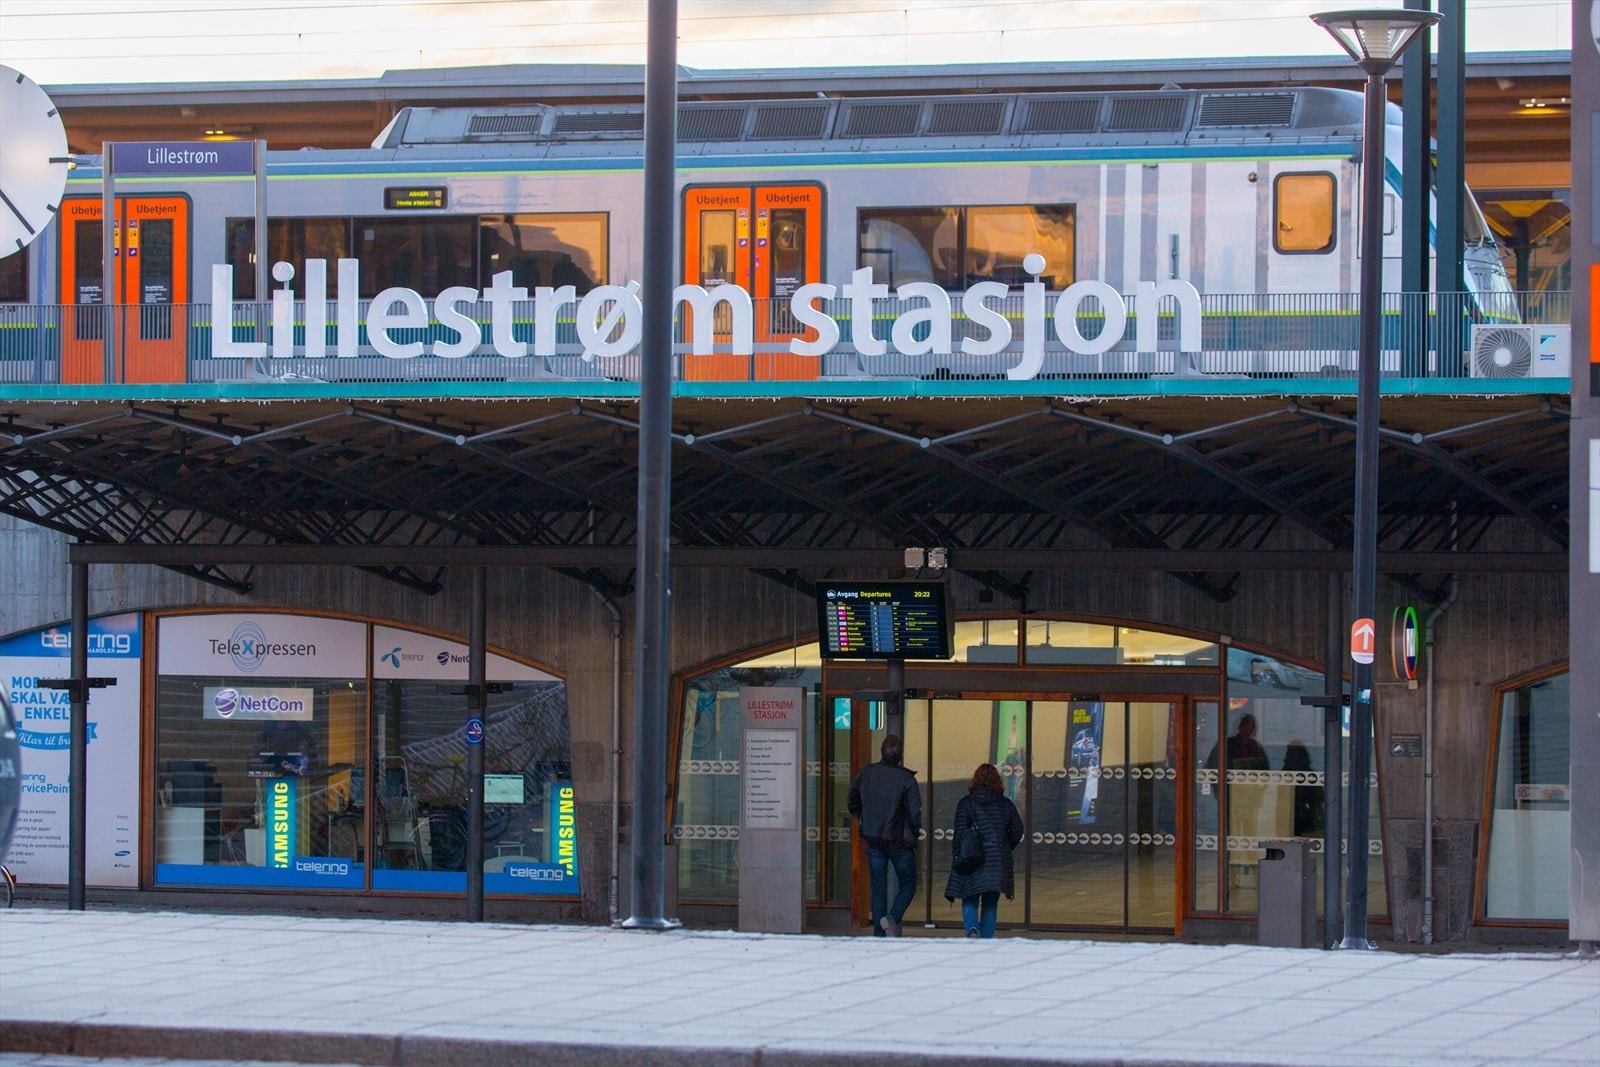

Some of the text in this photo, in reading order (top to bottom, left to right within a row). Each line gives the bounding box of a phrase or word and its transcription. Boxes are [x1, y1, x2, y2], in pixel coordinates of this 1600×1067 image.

[147, 148, 218, 164] Lillestrøm
[696, 195, 740, 206] Ubetjent
[766, 193, 810, 205] Ubetjent
[71, 205, 103, 217] Ubetje
[136, 204, 177, 215] Ubetjent
[211, 253, 1203, 381] Lillestrøm stasjon
[41, 631, 131, 654] telring
[209, 639, 316, 659] TeleXpressen
[401, 653, 425, 662] telenor
[451, 655, 469, 663] NetC
[11, 691, 46, 705] SKAL
[240, 696, 304, 712] NetCom
[748, 701, 794, 710] LILLESTRØM
[25, 707, 71, 720] ENKEL
[754, 711, 787, 720] STASJON
[22, 774, 46, 784] ering
[22, 783, 70, 793] rvicePoin
[274, 782, 289, 868] AMSUNG
[559, 787, 574, 876] AMSUNG
[296, 861, 348, 876] telering
[510, 867, 564, 881] telering
